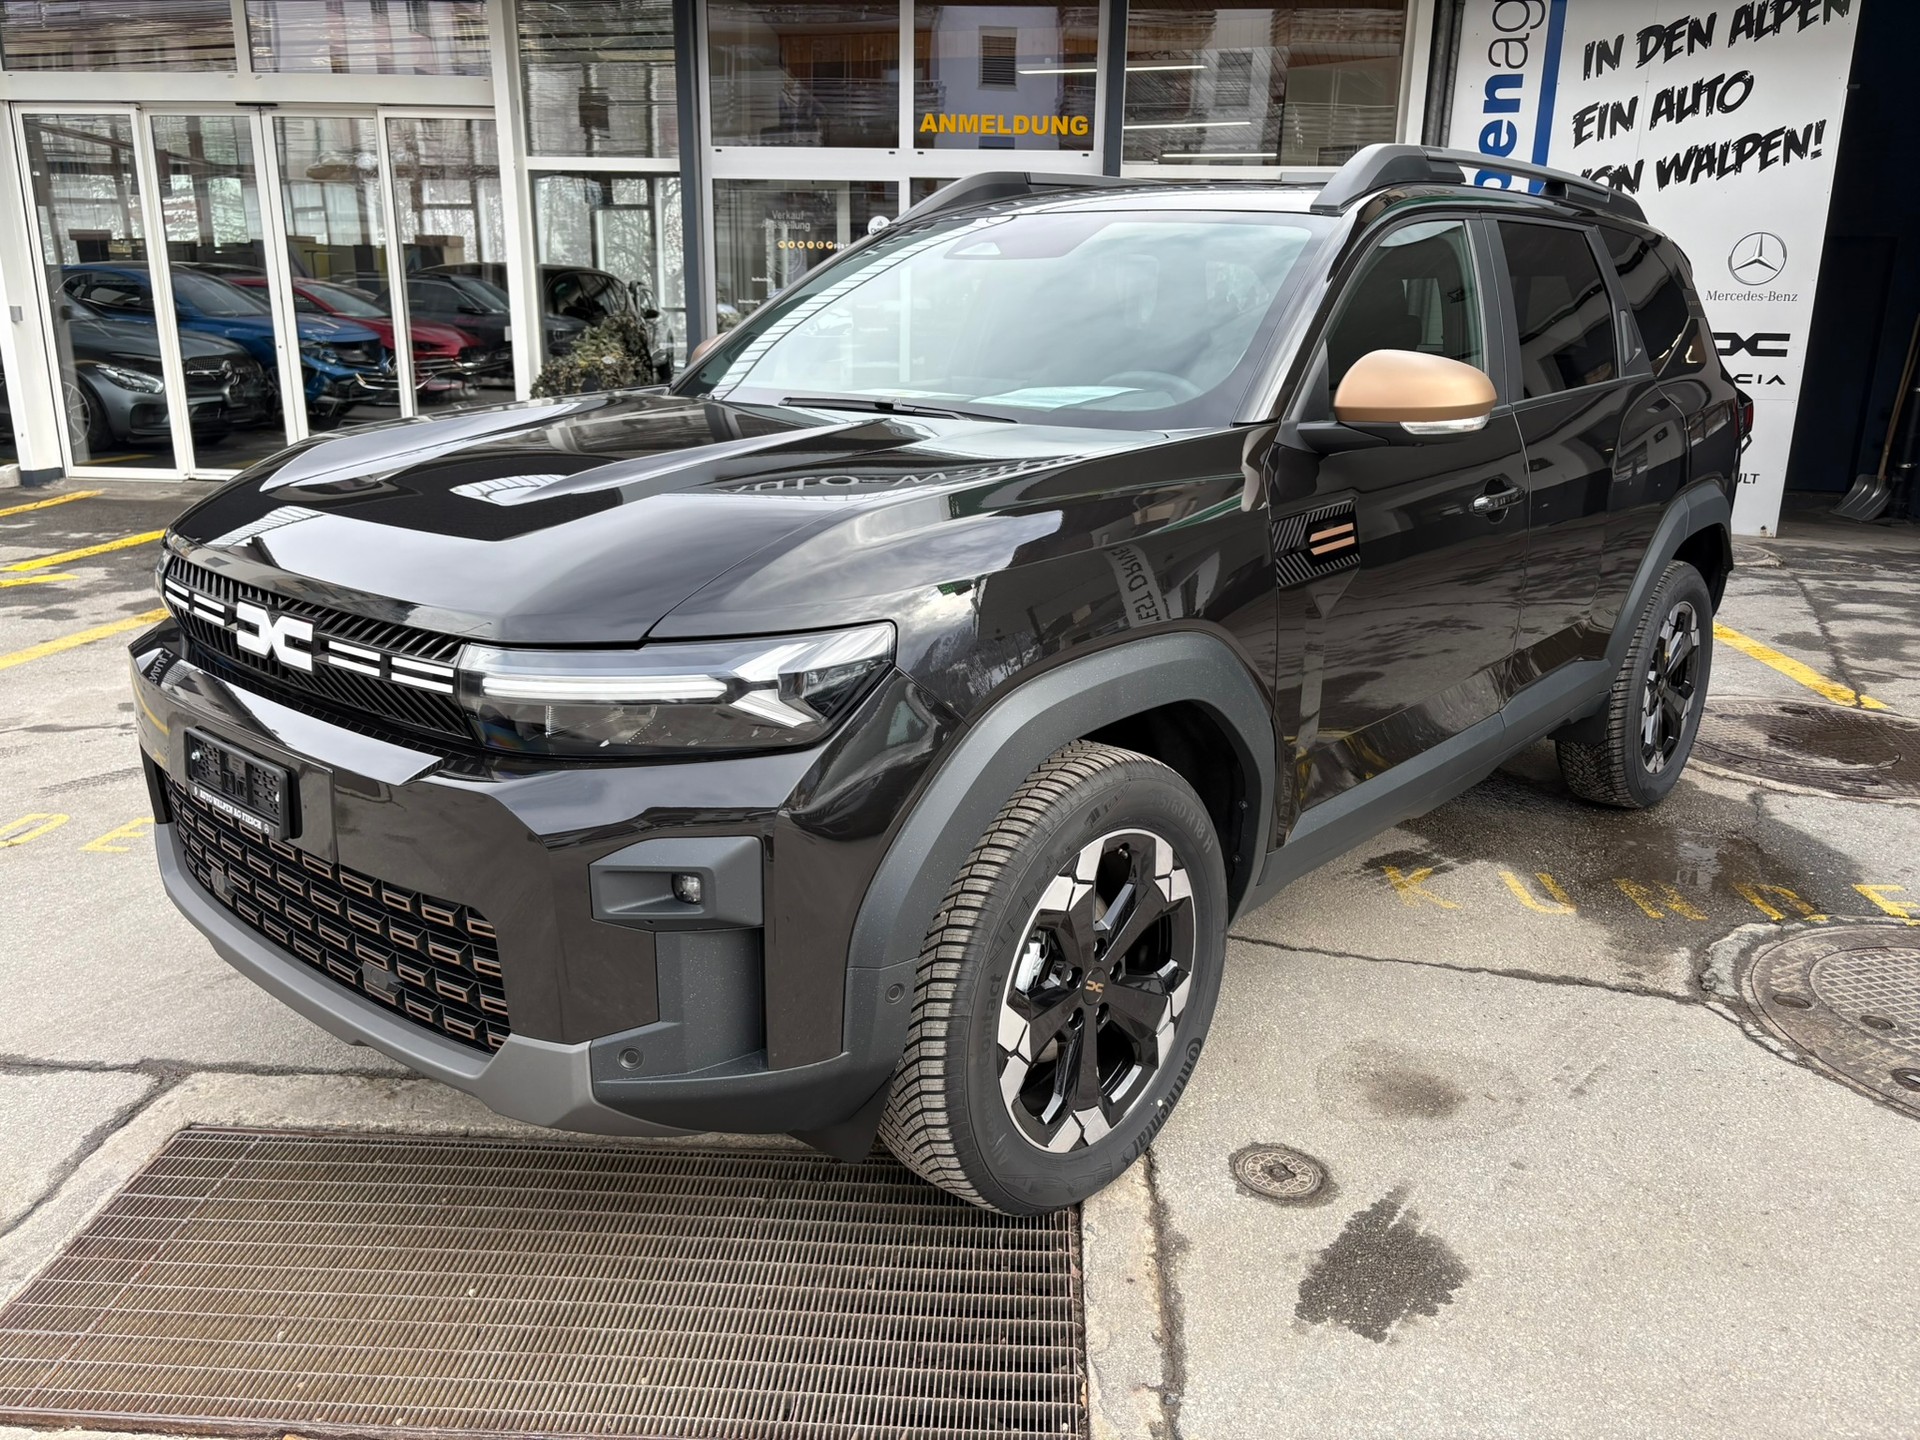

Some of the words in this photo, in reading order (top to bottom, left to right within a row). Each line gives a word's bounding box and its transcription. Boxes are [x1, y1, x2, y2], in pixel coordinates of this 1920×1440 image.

[1583, 34, 1624, 81] IN
[1635, 12, 1717, 69] DEN
[919, 113, 1089, 135] ANMELDUNG
[1572, 95, 1638, 149] EIN
[1649, 69, 1754, 131] AUTO
[1656, 119, 1827, 192] WALPEN!
[771, 210, 805, 220] Verkauf
[1705, 290, 1799, 302] Mercedes-Benz
[1130, 1037, 1203, 1158] Continental
